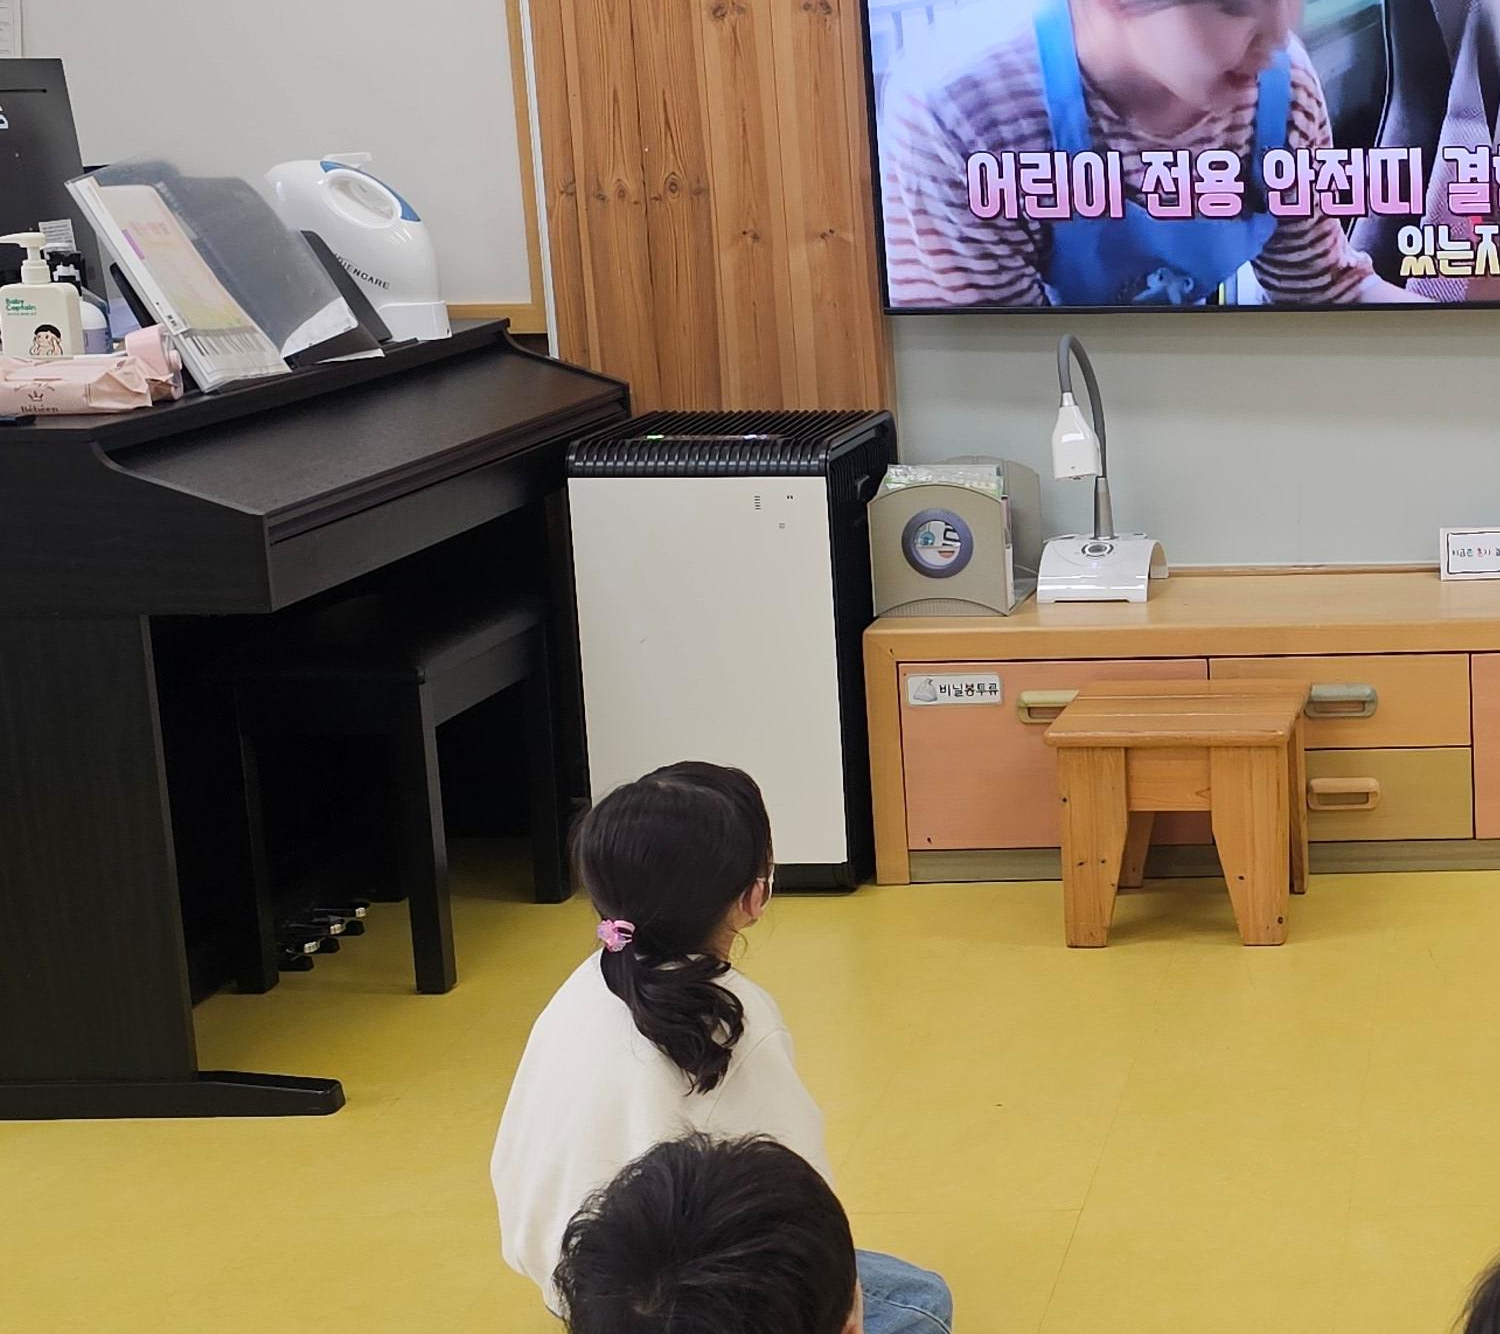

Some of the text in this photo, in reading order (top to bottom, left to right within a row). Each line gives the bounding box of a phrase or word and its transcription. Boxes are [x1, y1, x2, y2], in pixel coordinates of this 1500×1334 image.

[965, 149, 1123, 219] 어린이
[1141, 148, 1245, 219] 전용
[1262, 146, 1426, 217] 안전띠
